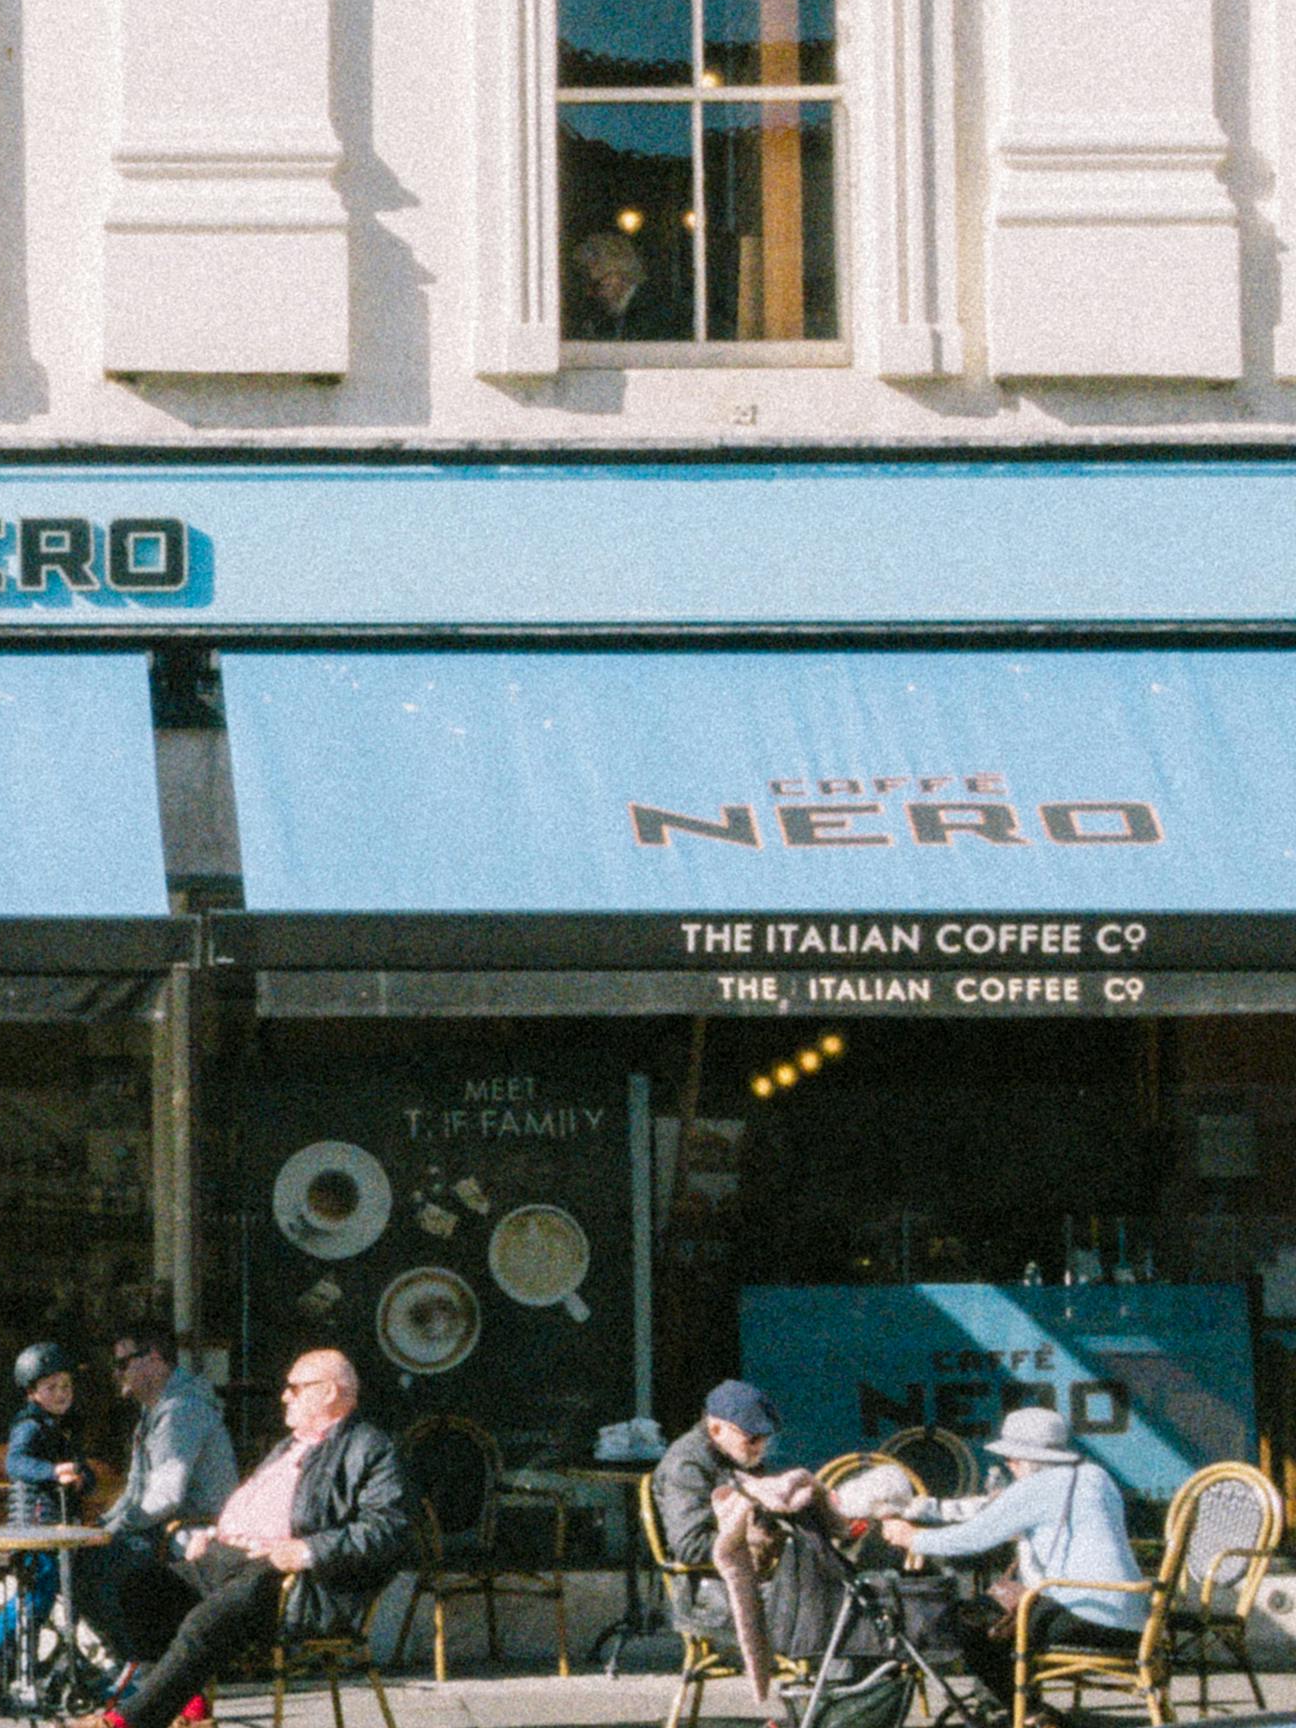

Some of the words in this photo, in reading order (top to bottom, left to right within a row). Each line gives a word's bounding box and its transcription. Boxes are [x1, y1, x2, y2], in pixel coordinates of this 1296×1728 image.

[627, 801, 1166, 851] NERO
[681, 923, 752, 955] THE
[766, 923, 920, 955] ITALIAN
[936, 923, 1081, 955] COFFEE
[718, 976, 778, 1001] THE
[809, 976, 931, 1002] ITALIAN
[956, 976, 1079, 1002] COFFEE
[465, 1077, 534, 1101] MEET
